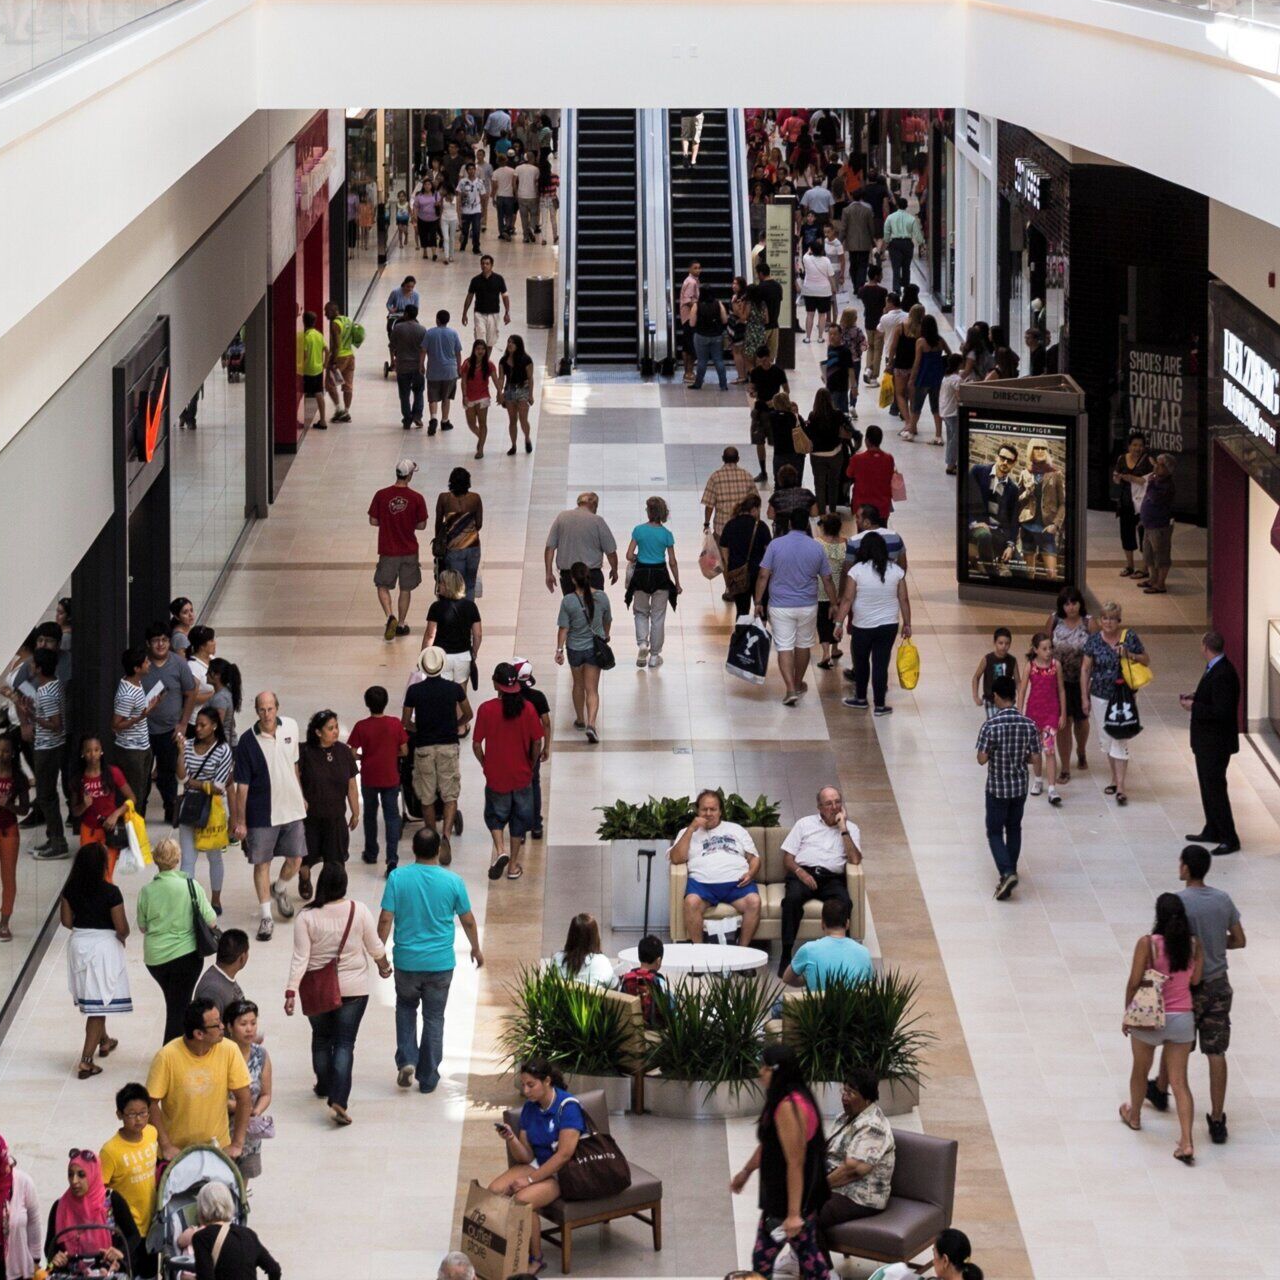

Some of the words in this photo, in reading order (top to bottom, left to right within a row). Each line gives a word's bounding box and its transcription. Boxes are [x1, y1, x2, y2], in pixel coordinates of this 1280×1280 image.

[1129, 351, 1162, 373] SHOES
[1163, 355, 1182, 375] ARE
[992, 390, 1042, 403] DIRECTORY
[1129, 371, 1183, 402] BORING
[984, 423, 1011, 431] TOMMY
[1129, 397, 1182, 433] WEAR
[1129, 428, 1183, 453] EAKERS
